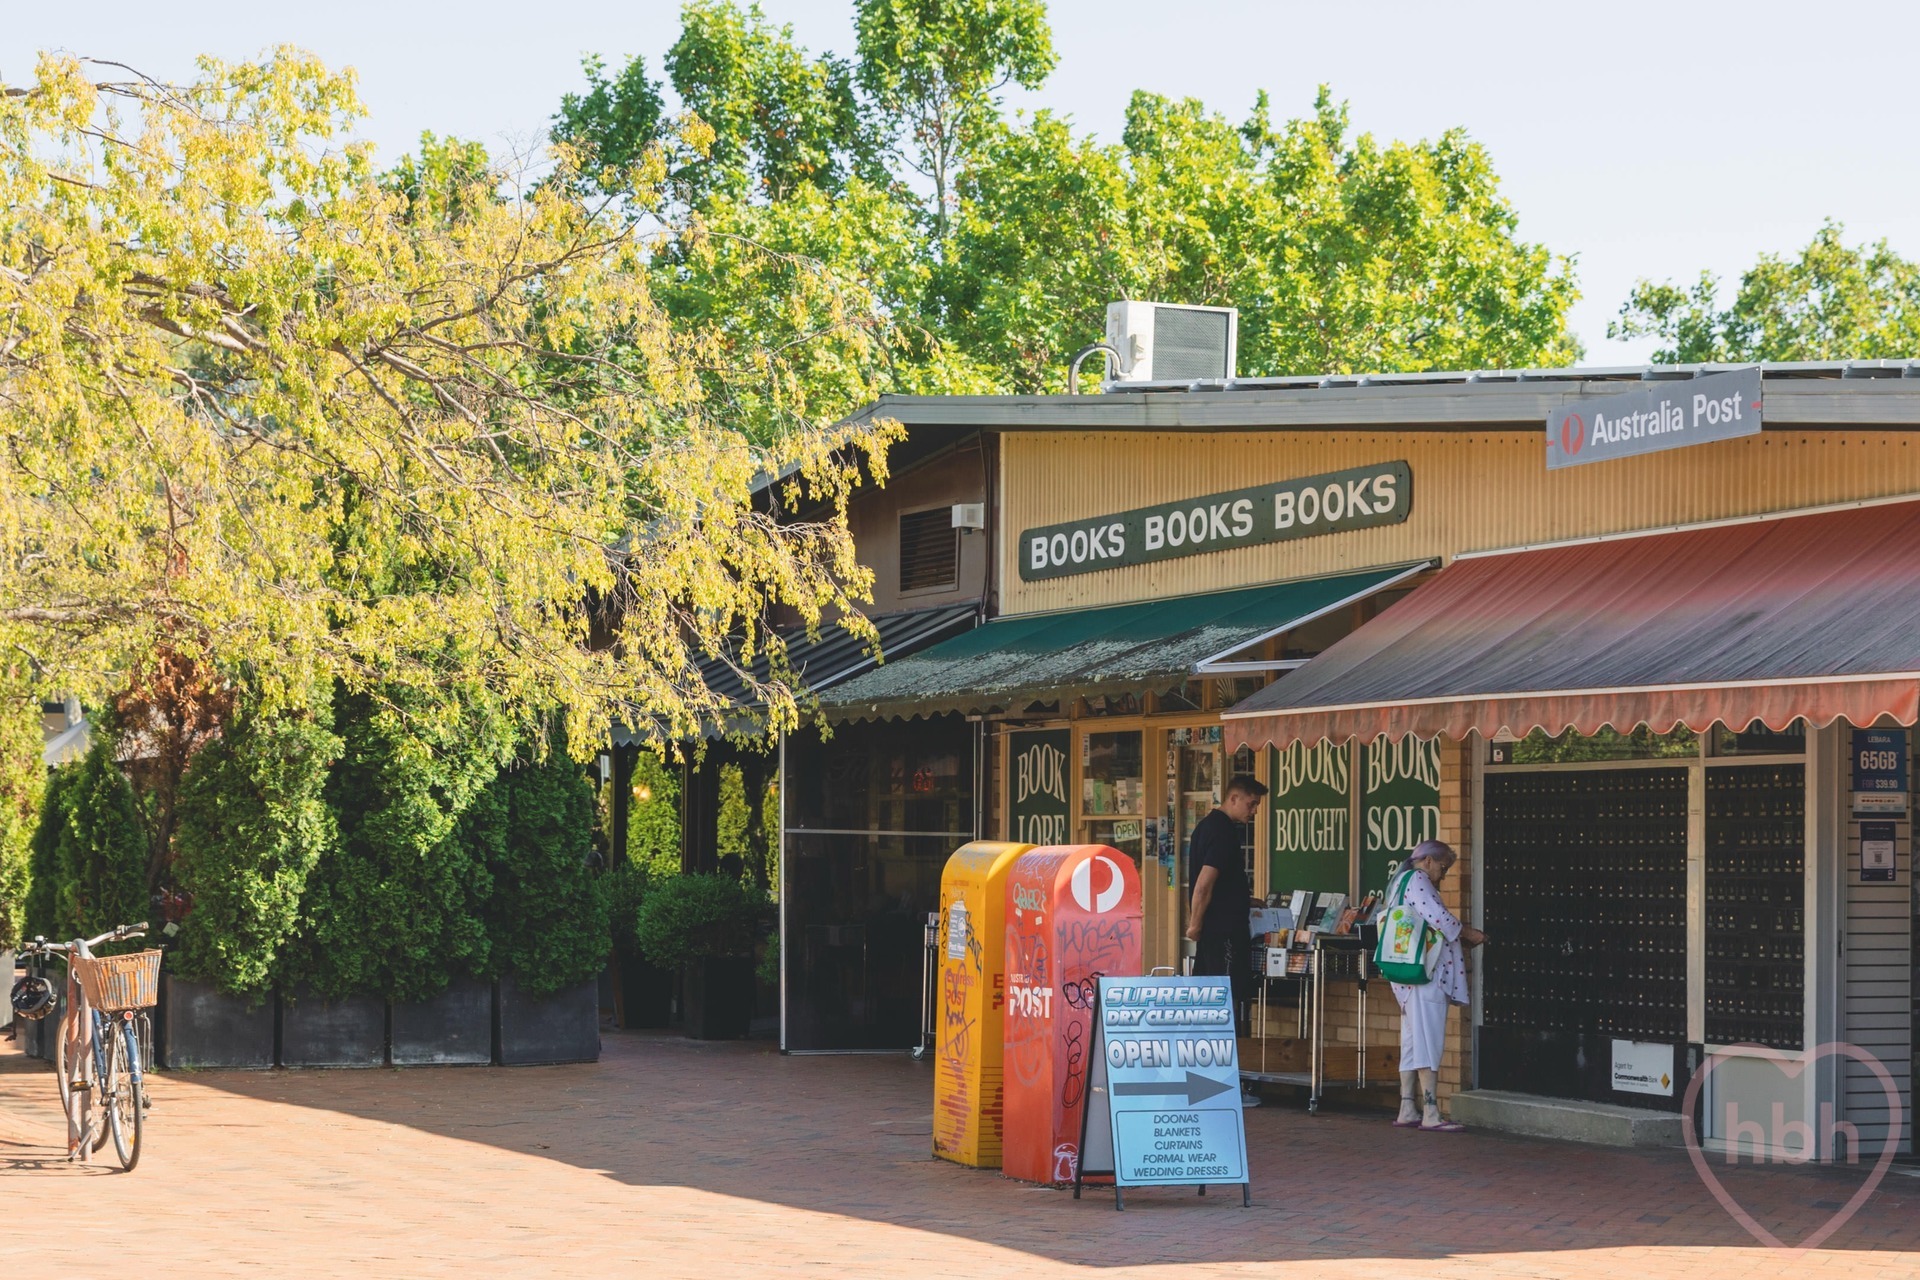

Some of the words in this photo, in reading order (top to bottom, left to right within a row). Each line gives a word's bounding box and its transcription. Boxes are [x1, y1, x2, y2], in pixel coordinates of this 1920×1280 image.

[1591, 400, 1684, 446] Australia
[1693, 390, 1742, 427] Post
[1031, 523, 1125, 570] BOOKS
[1145, 499, 1253, 551] BOOKS
[1274, 474, 1396, 530] BOOKS
[1277, 736, 1348, 797] BOOKS
[1367, 732, 1441, 794] BOOKS
[1860, 750, 1897, 770] 65GB
[1017, 743, 1066, 803] BOOK
[1115, 824, 1138, 838] OPEN
[1276, 808, 1347, 851] BOUGHT
[1367, 805, 1441, 851] SOLD
[946, 990, 966, 1005] POST
[1010, 986, 1052, 1018] POST
[1105, 987, 1228, 1007] SUPREME
[1106, 1010, 1145, 1025] DRY
[1145, 1009, 1230, 1025] CLEANERS
[1108, 1039, 1170, 1068] OPEN
[1177, 1039, 1233, 1067] NOW
[1614, 1062, 1626, 1070] Agent
[1614, 1073, 1648, 1082] Commonwealth
[1153, 1114, 1199, 1124] DOONAS
[1154, 1127, 1201, 1137] BLANKETS
[1154, 1140, 1203, 1150] CURTAINS
[1142, 1154, 1185, 1163] FORMAL
[1188, 1153, 1217, 1163] WEAR
[1133, 1167, 1184, 1177] WEDDING
[1186, 1166, 1228, 1176] DRESSES
